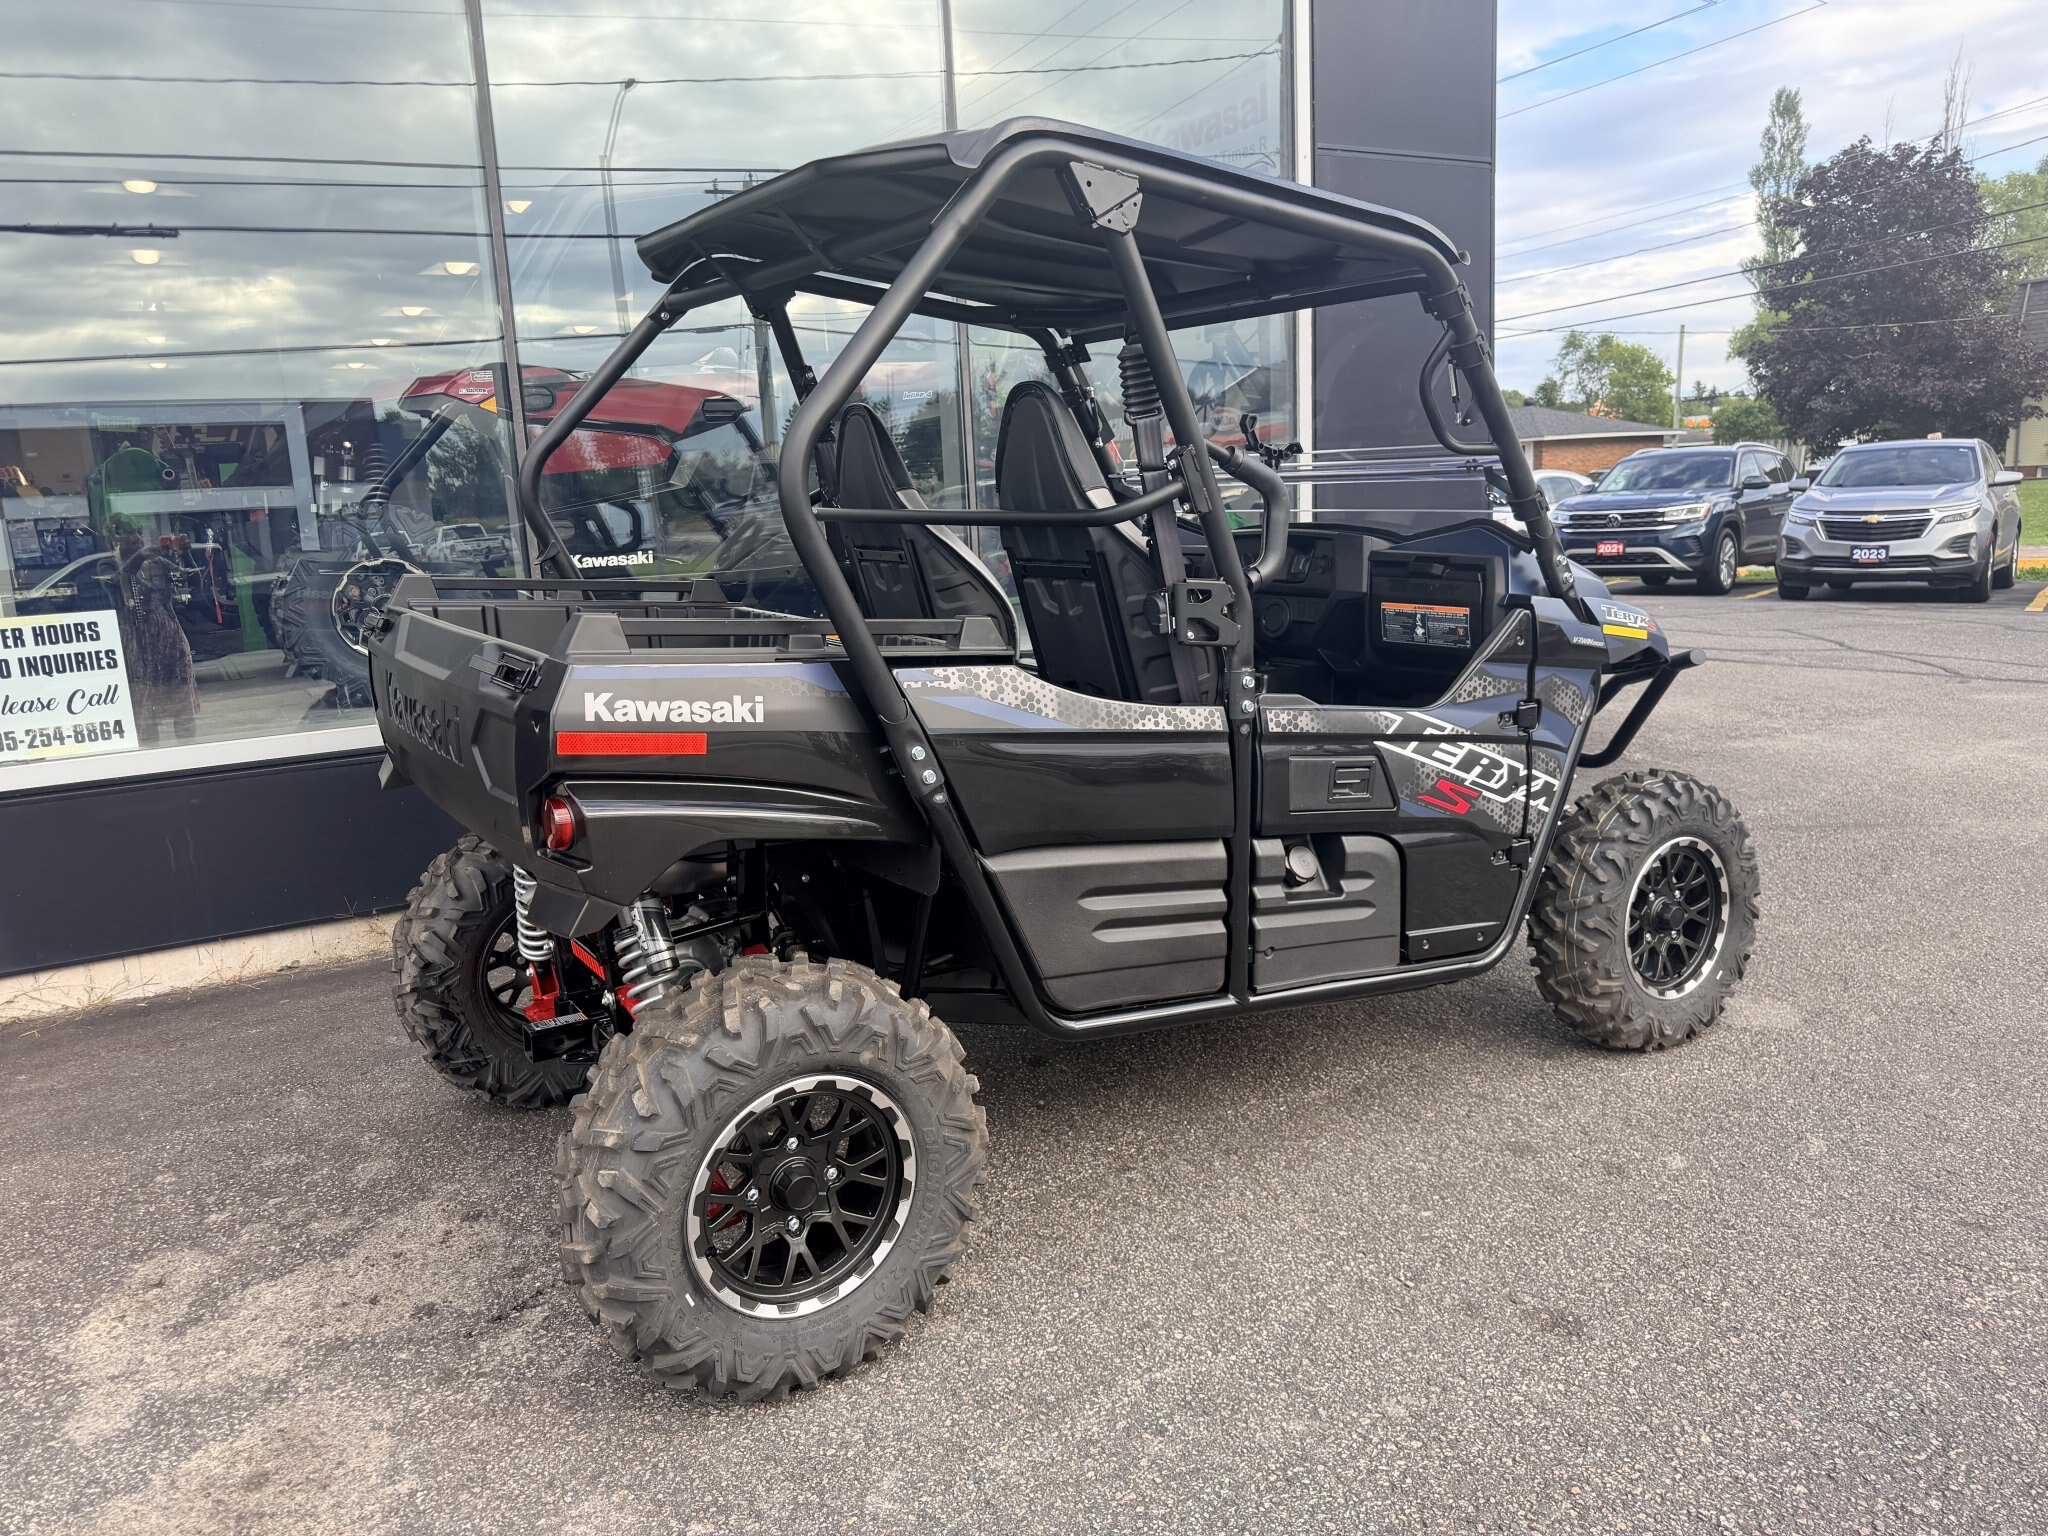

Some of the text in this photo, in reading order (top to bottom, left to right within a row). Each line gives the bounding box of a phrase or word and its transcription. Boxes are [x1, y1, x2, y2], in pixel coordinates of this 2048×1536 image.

[570, 550, 653, 569] Kawasaki
[1597, 543, 1624, 553] 2021
[1852, 548, 1886, 559] 2023
[31, 621, 101, 647] HOURS
[17, 649, 119, 678] INQUIRIES
[1, 683, 120, 716] lease Call
[584, 692, 764, 723] Kawasaki
[385, 669, 464, 767] Kawasaki
[1417, 779, 1479, 815] S
